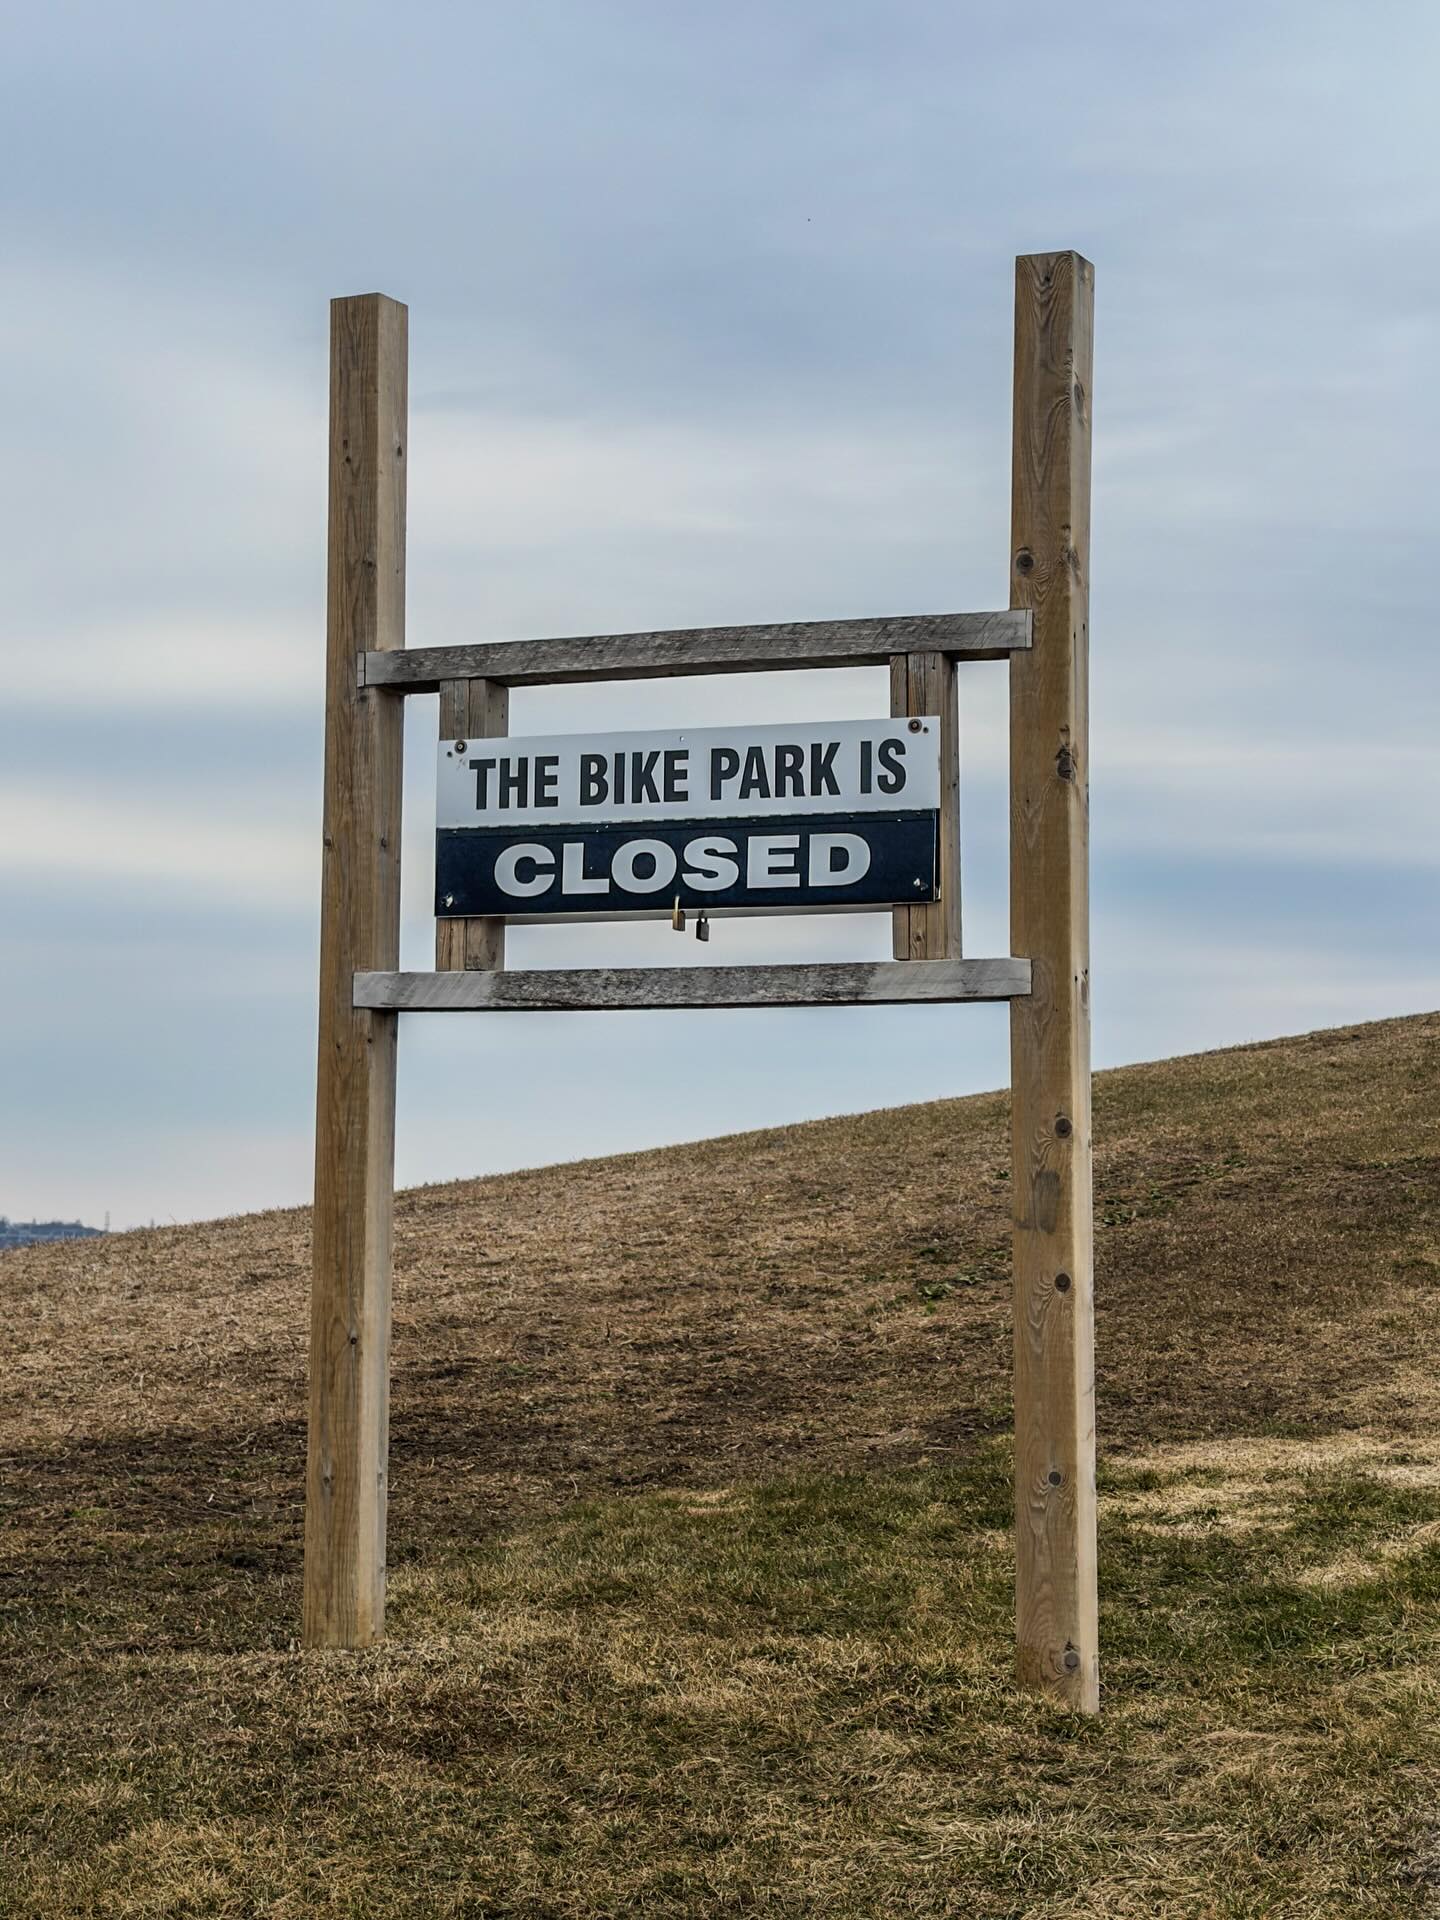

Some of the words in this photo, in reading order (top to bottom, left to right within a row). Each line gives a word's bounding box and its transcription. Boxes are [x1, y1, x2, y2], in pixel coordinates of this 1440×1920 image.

[468, 756, 560, 811] THE
[579, 749, 690, 807] BIKE
[710, 741, 841, 801] PARK
[859, 738, 907, 795] IS
[494, 833, 871, 897] CLOSED
